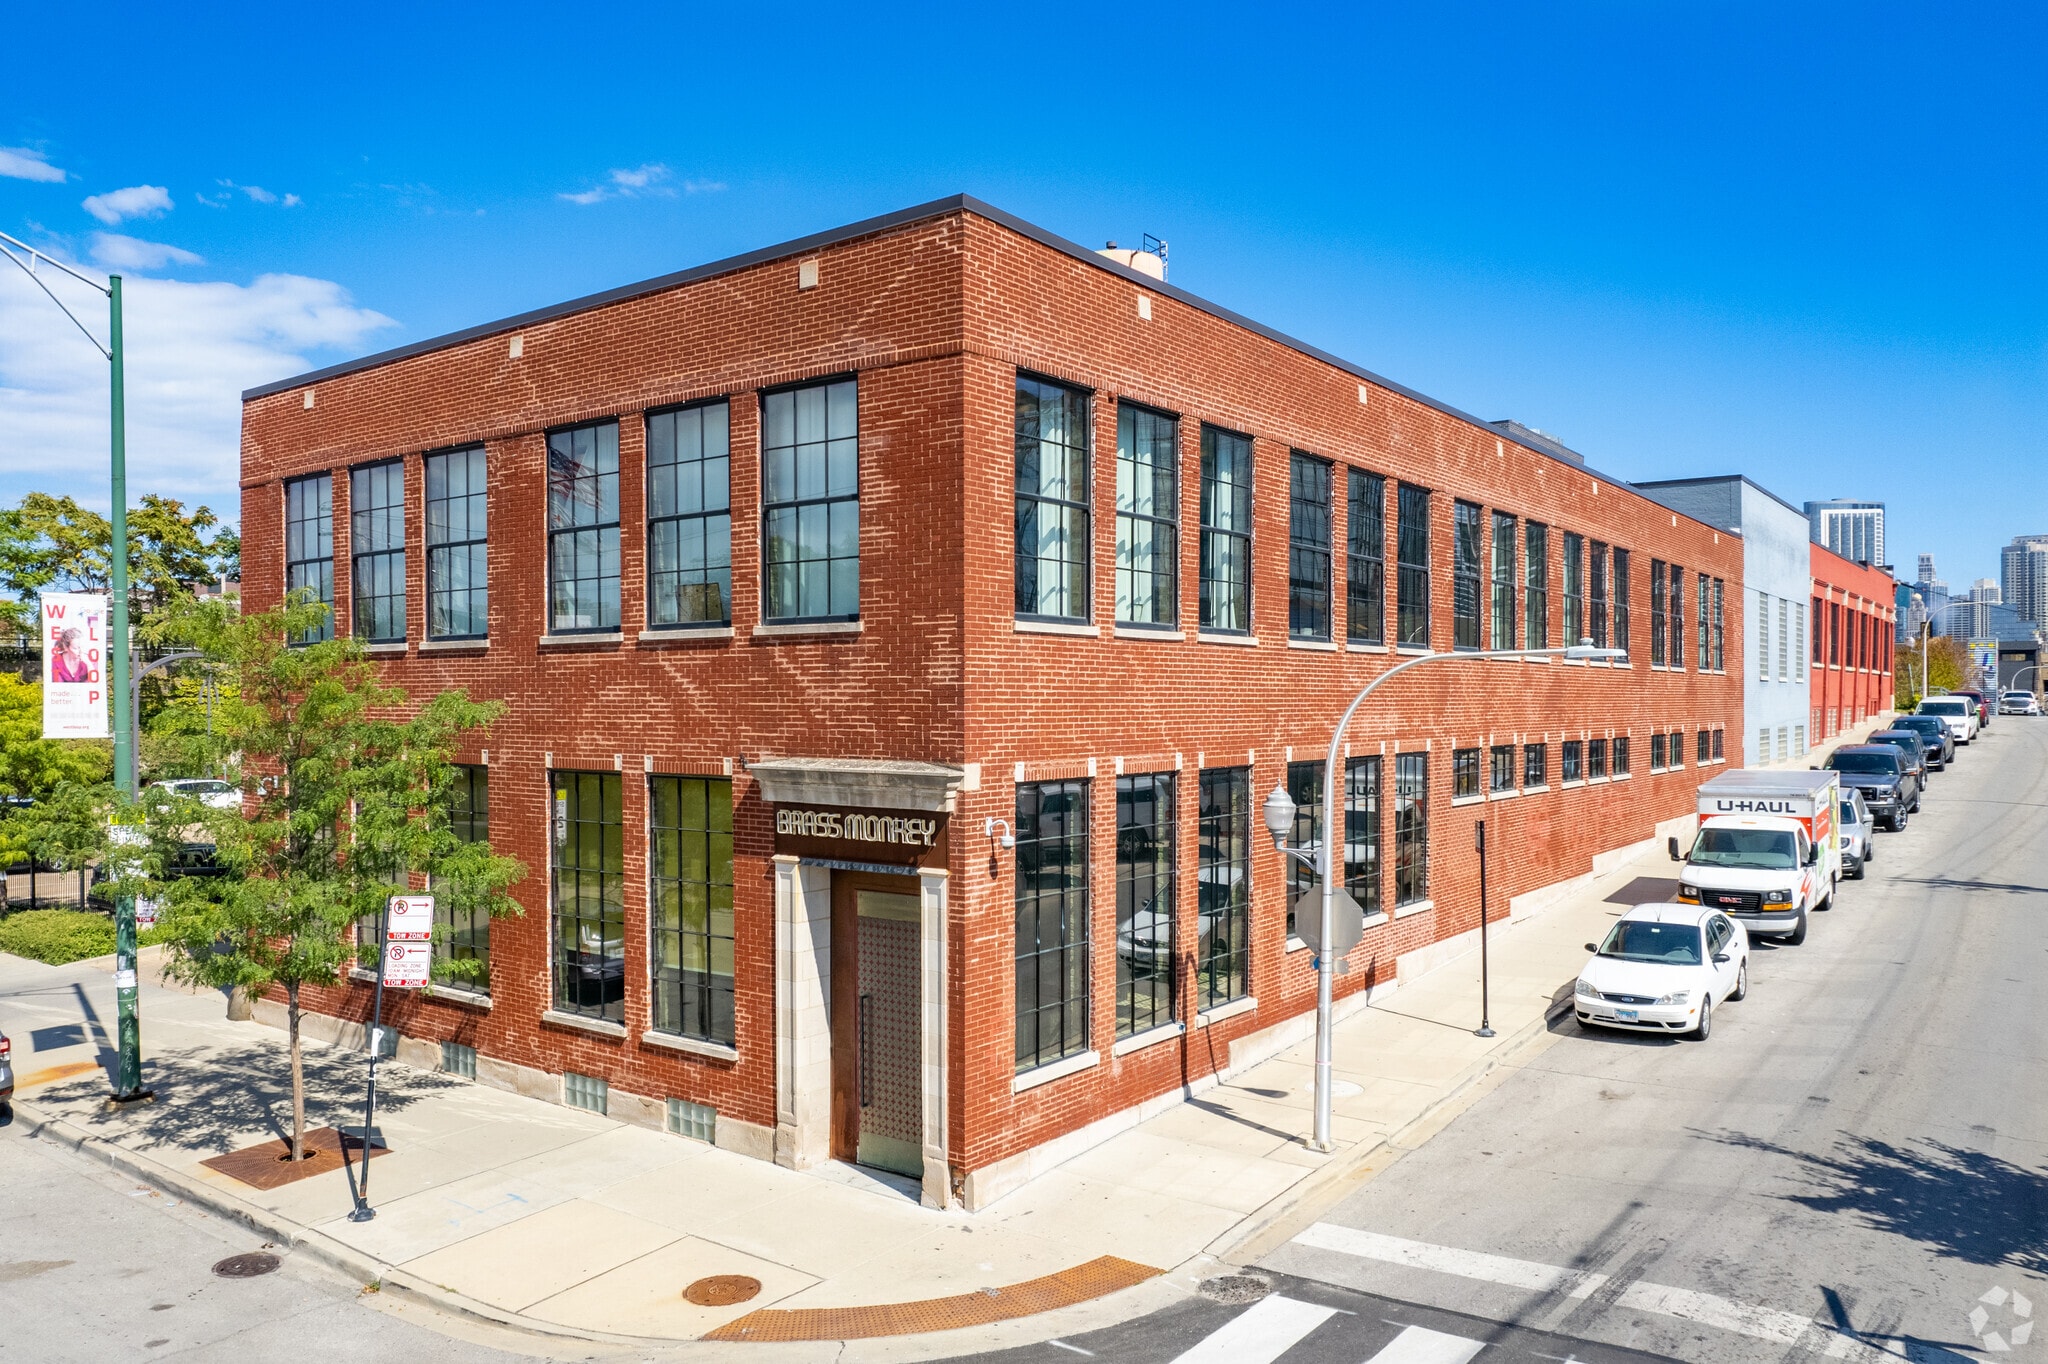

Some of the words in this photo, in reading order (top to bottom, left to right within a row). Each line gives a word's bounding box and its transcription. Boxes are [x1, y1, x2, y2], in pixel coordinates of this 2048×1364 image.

[46, 604, 66, 683] WEST
[88, 627, 100, 704] LOOP
[1717, 800, 1797, 813] U-HAUL
[776, 809, 843, 838] BRASS
[845, 813, 936, 847] MONKEY
[1719, 896, 1743, 904] GMC
